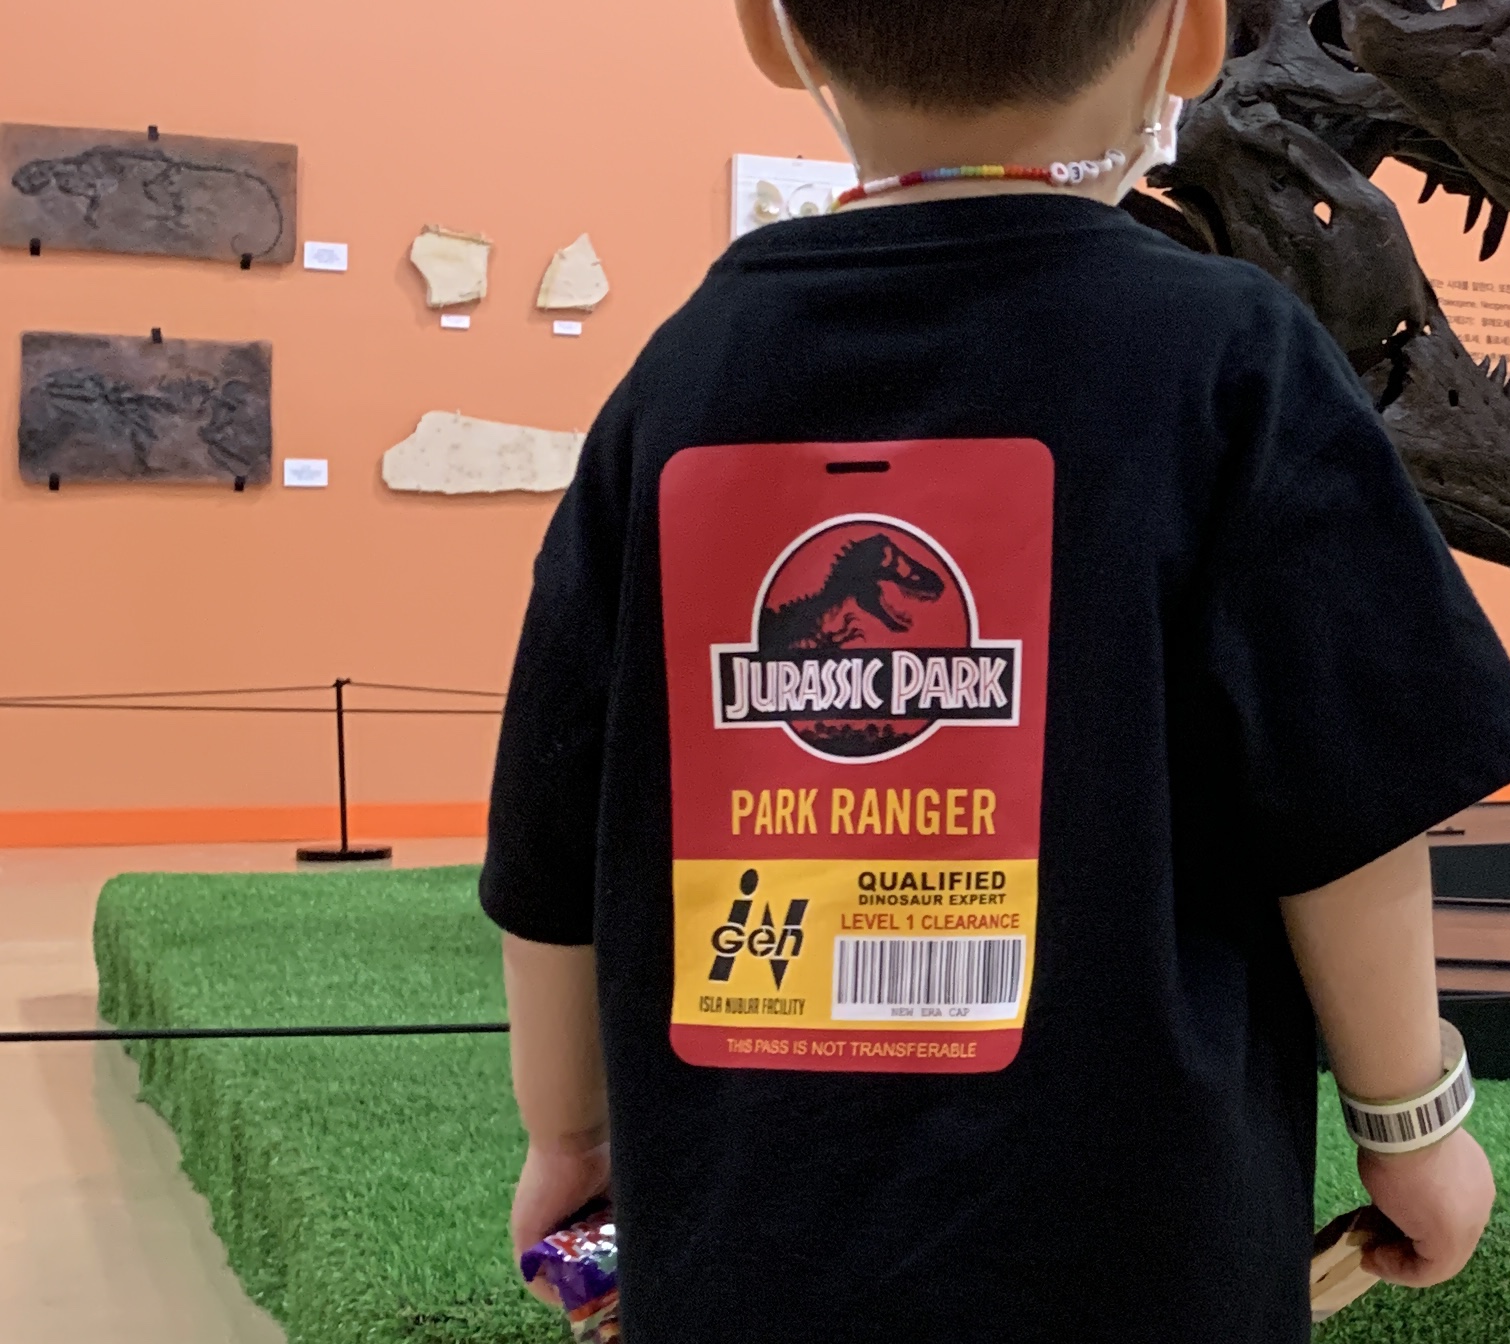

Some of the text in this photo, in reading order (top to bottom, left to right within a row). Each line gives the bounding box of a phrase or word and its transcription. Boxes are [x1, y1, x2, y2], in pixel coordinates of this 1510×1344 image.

[726, 650, 1009, 720] JURASSIC PARK
[731, 787, 997, 836] PARK RANGER
[858, 871, 1006, 892] QUALIFIED
[859, 893, 1006, 906] DINOSAUR EXPERT
[841, 913, 1020, 931] LEVEL 1 CLEARANCE
[699, 996, 807, 1016] ISLA NUBLAR FACILITY
[890, 1007, 971, 1017] NEW ERA CAP
[727, 1038, 978, 1058] THIS PASS IS NOT TRANSFERABLE
